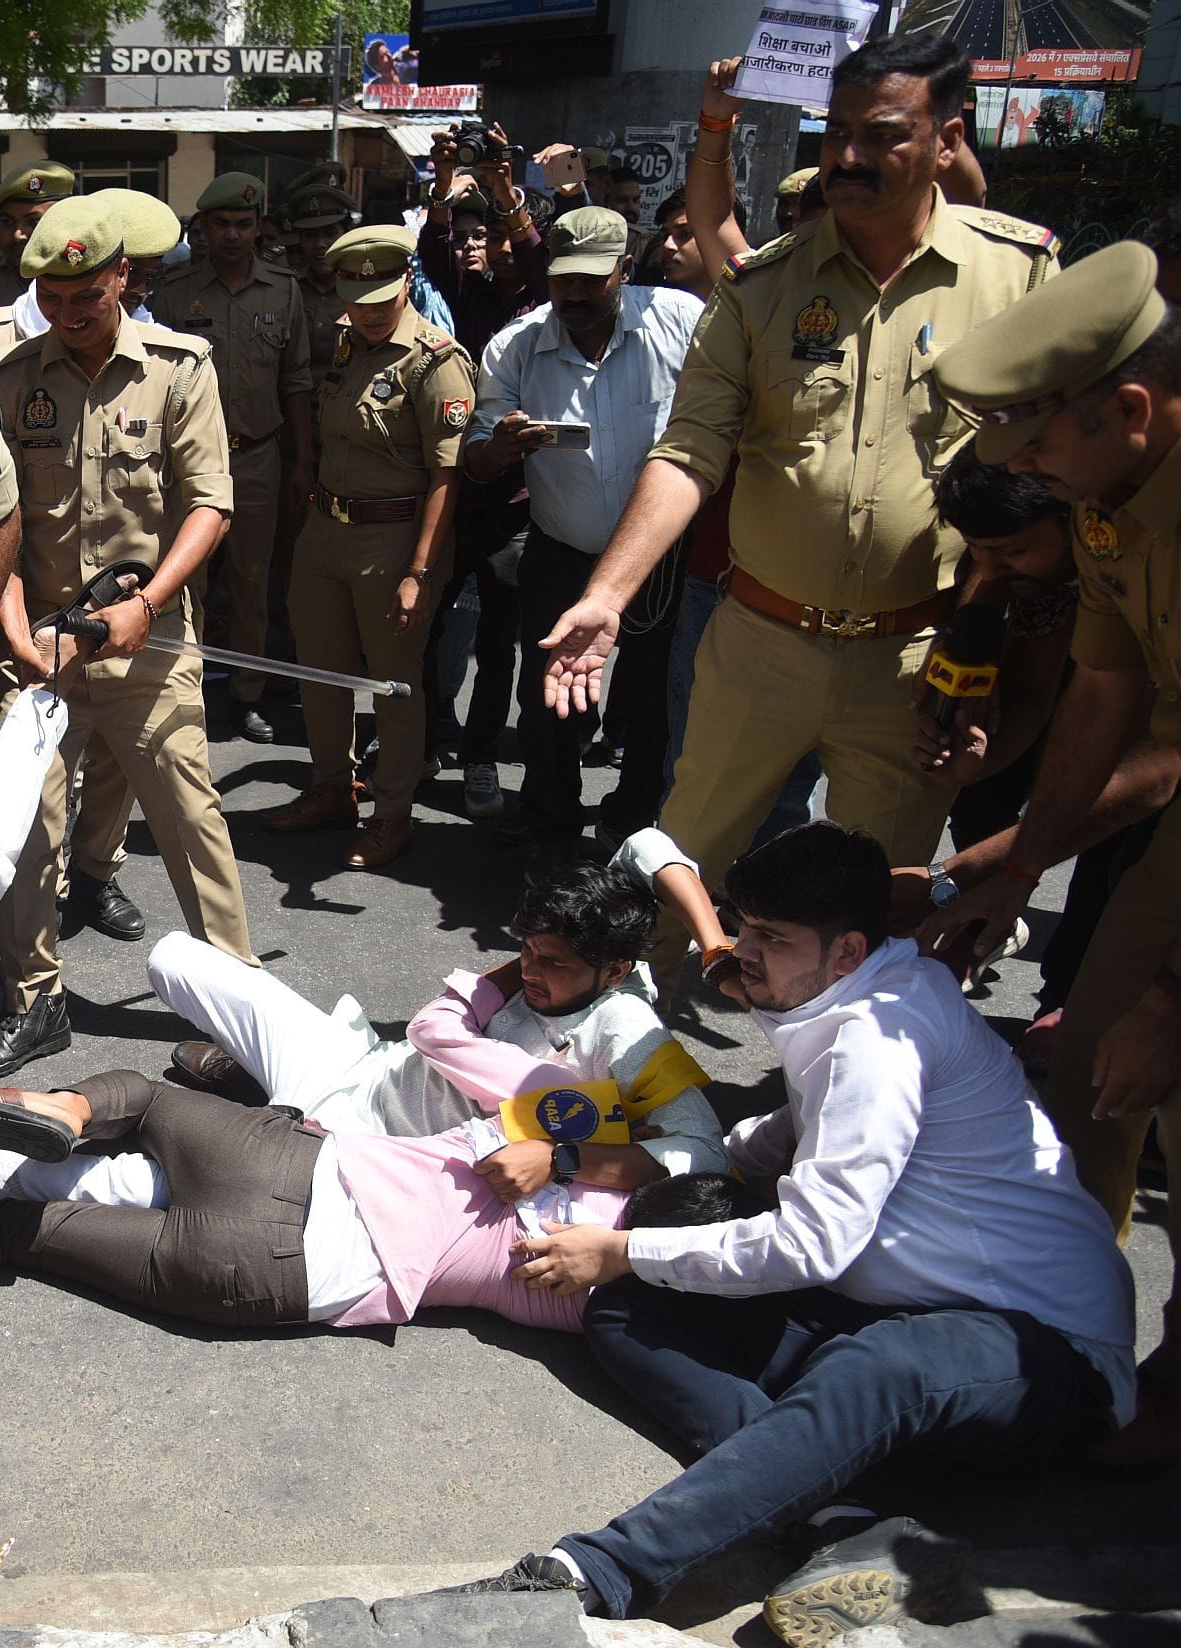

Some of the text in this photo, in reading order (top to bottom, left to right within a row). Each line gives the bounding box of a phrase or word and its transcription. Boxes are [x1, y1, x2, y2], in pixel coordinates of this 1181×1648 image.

[832, 19, 855, 32] ASAP
[758, 32, 832, 56] शिक्षा बचाओ
[111, 48, 232, 74] SPORTS
[239, 49, 324, 74] WEAR
[1026, 53, 1047, 62] 2026
[1054, 67, 1062, 77] 15
[630, 153, 667, 178] 205
